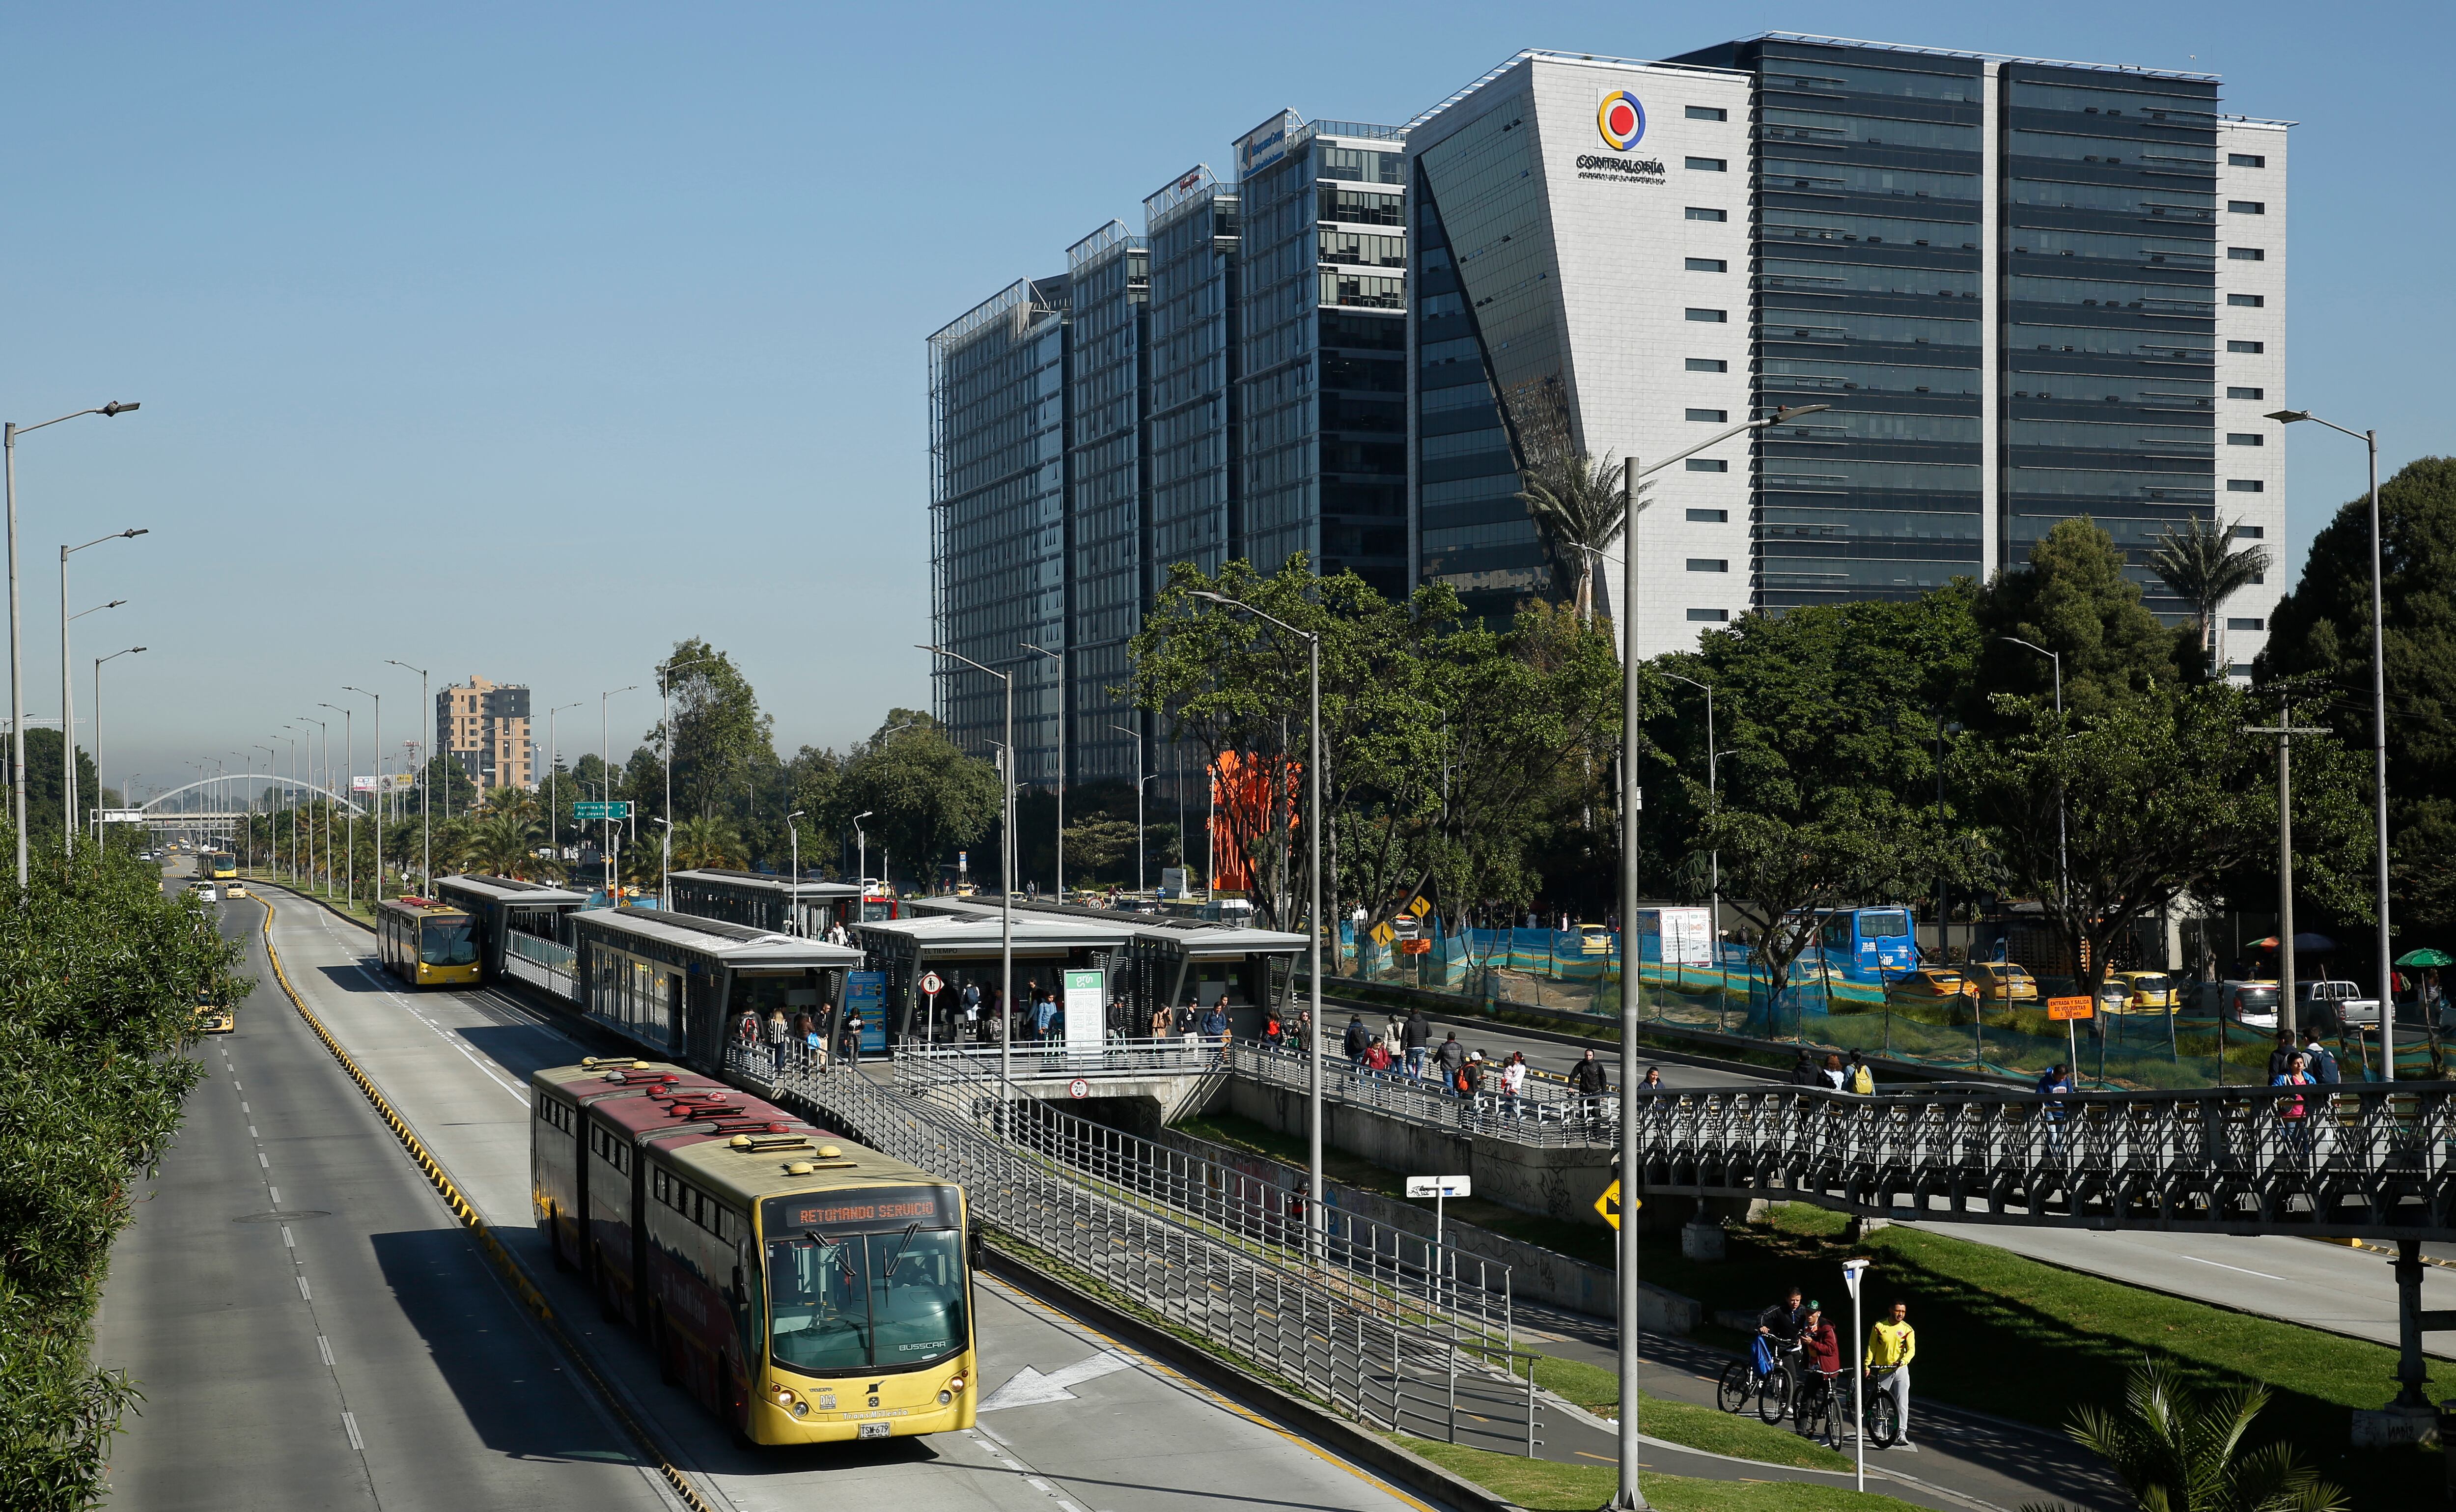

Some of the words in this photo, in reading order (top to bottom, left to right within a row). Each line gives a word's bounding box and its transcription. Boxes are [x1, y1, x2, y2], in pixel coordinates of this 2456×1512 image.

[1576, 155, 1666, 176] CONTRALORÍA
[1578, 172, 1607, 181] GENERAL
[800, 1206, 874, 1223] RETOMANDO
[879, 1202, 933, 1218] SERVICIO
[899, 1341, 946, 1351] BUSSCAR
[820, 1394, 836, 1405] D126
[843, 1409, 908, 1420] TransMilenio
[861, 1425, 889, 1434] TSM-679
